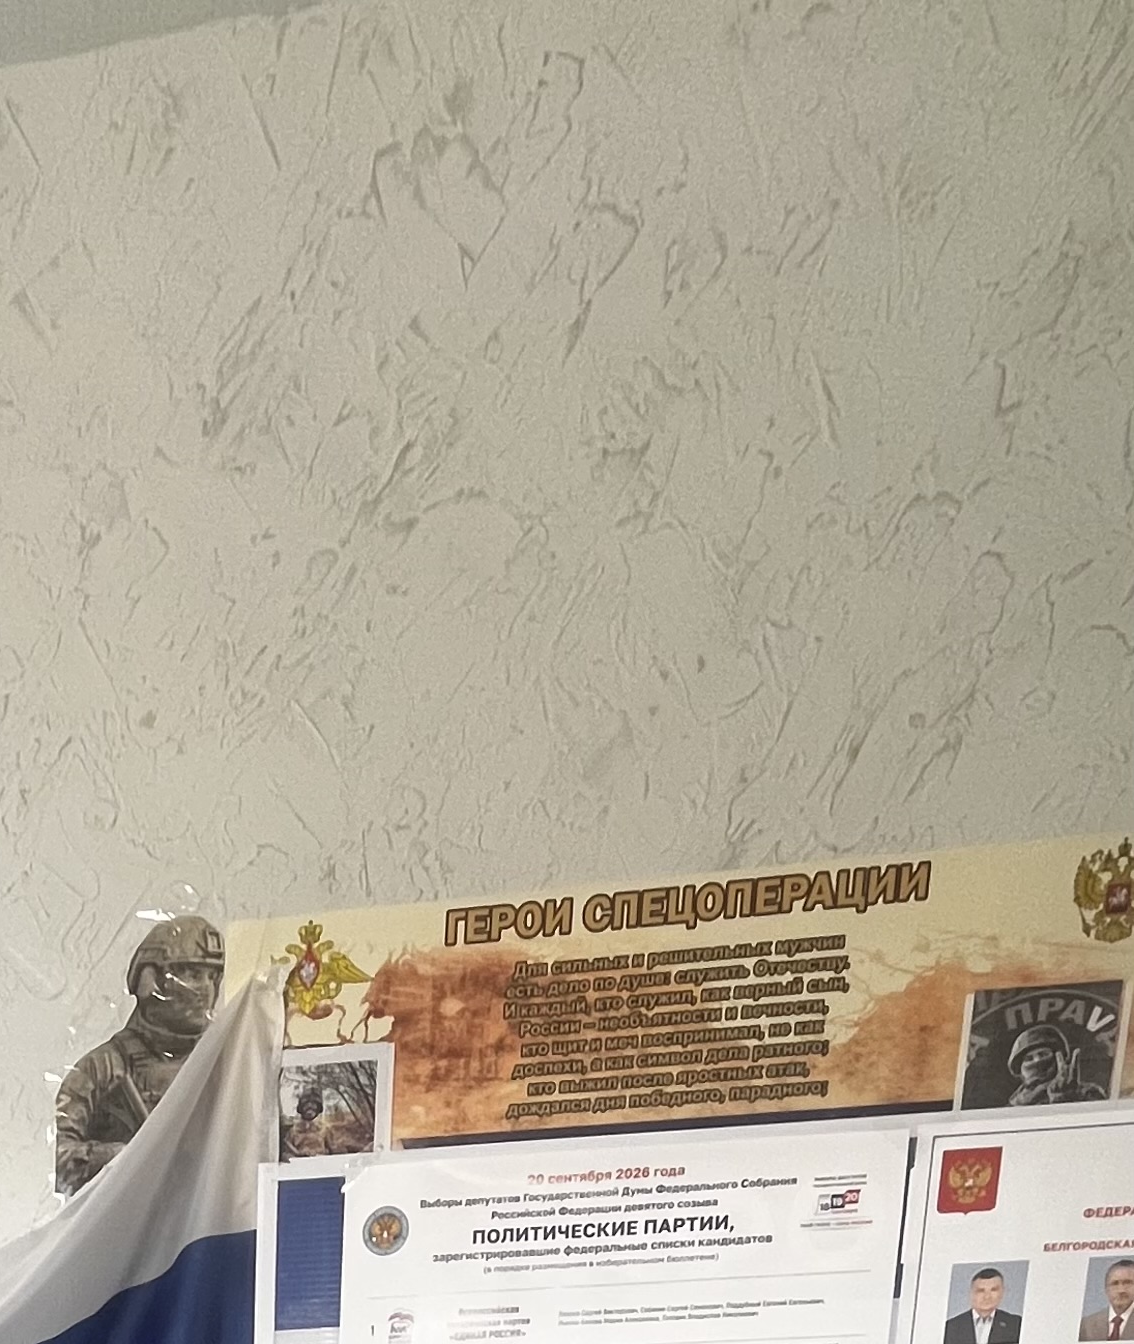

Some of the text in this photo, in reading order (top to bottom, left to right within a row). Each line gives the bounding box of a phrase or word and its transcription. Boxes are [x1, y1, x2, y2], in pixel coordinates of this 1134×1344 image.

[444, 861, 932, 948] ГЕРОИ СПЕЦОПЕРАЦИИ
[514, 934, 846, 982] Для сильных и решительных мужчин
[506, 981, 544, 999] есть
[546, 978, 589, 998] дело
[592, 978, 616, 994] по
[673, 962, 750, 986] служить
[503, 977, 850, 1019] И каждый, кто служил, как верный сын,
[519, 999, 830, 1038] России необъятности и вечности,
[520, 1042, 549, 1058] кто
[551, 1038, 589, 1057] щит
[605, 1034, 639, 1051] меч
[640, 1024, 765, 1050] воспринимал,
[768, 1023, 792, 1038] не
[794, 1020, 825, 1035] как
[511, 1061, 589, 1081] доспехи,
[590, 1058, 604, 1073] а
[605, 1056, 635, 1071] как
[636, 1051, 703, 1069] символ
[704, 1047, 750, 1065] дела
[527, 1062, 810, 1097] кто выжил после яростных атак,
[505, 1099, 591, 1120] дождался
[592, 1096, 627, 1114] дня
[527, 1165, 686, 1185] 20 сентября 2026 года
[420, 1193, 462, 1209] Выборы
[465, 1194, 520, 1206] депутатов
[523, 1188, 619, 1204] Государственной
[621, 1186, 653, 1199] Думы
[655, 1180, 739, 1194] Федерального
[740, 1176, 798, 1189] Собрания
[491, 1198, 718, 1220] Российской Федерации девятого созыва
[1083, 1206, 1134, 1218] ФЕДЕР
[472, 1214, 735, 1245] ПОЛИТИЧЕСКИЕ ПАРТИИ,
[433, 1233, 773, 1263] зарегистрировавшие федеральные списки кандидатов
